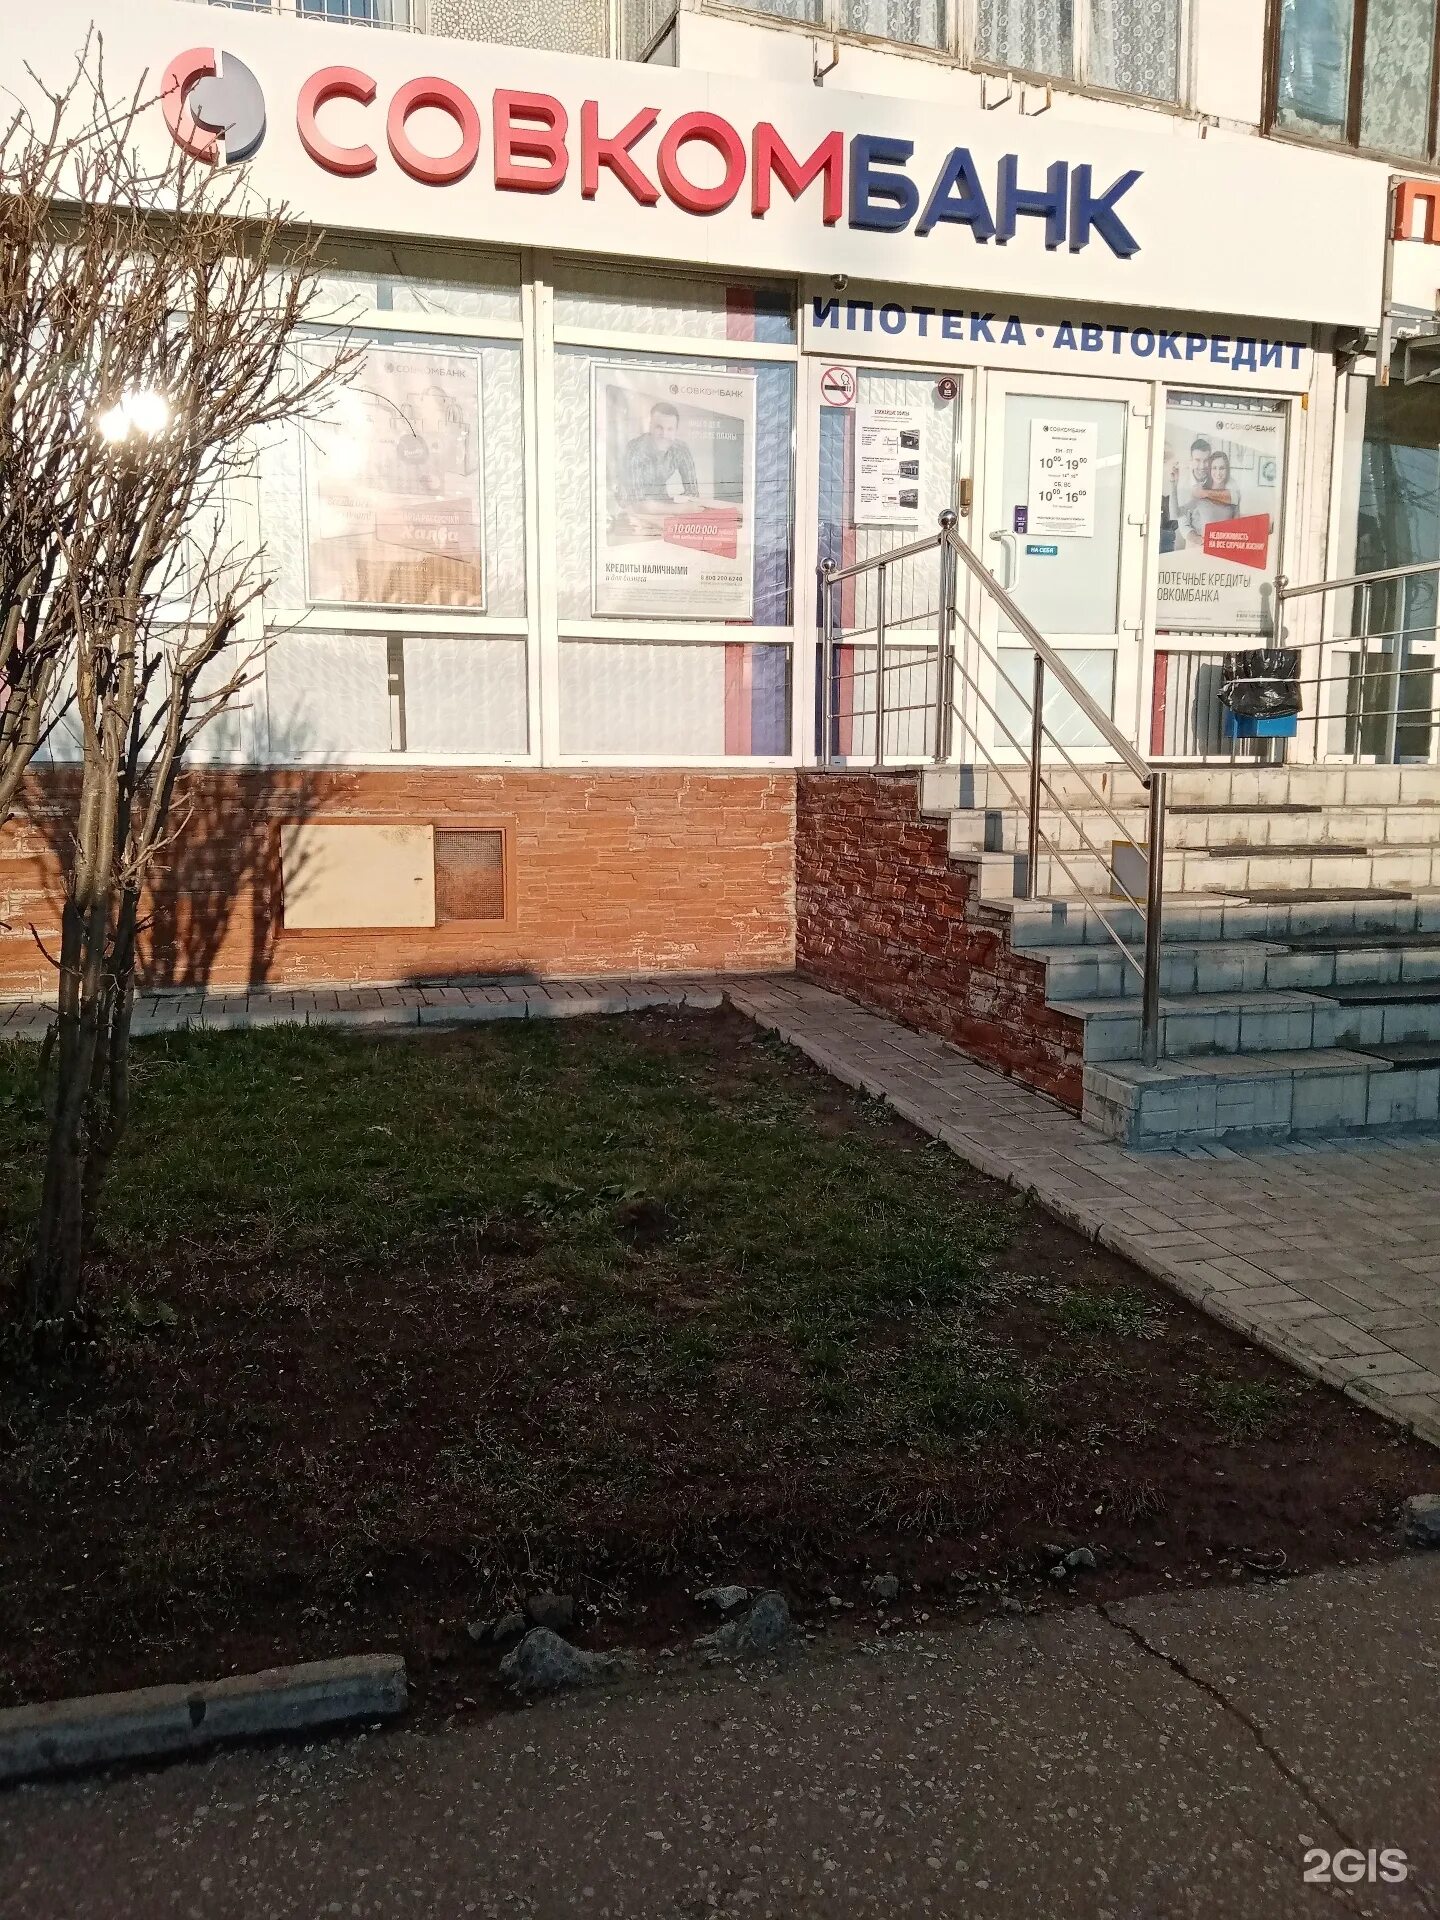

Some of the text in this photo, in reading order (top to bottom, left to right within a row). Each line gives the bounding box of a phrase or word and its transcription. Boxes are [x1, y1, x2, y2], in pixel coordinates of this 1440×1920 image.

[296, 65, 1144, 260] СОВКОМБАНК
[811, 295, 1308, 372] ИПОТЕКА АВТОКРЕДИТ
[396, 364, 466, 378] СОВОМБАНК
[1225, 422, 1277, 433] СОВКОМБАНК
[1039, 546, 1055, 554] СЕБЯ
[605, 563, 641, 574] КРЕДИТЫ
[642, 565, 688, 576] НАЛИЧНЫМИ
[1208, 573, 1251, 588] КРЕДИТЫ
